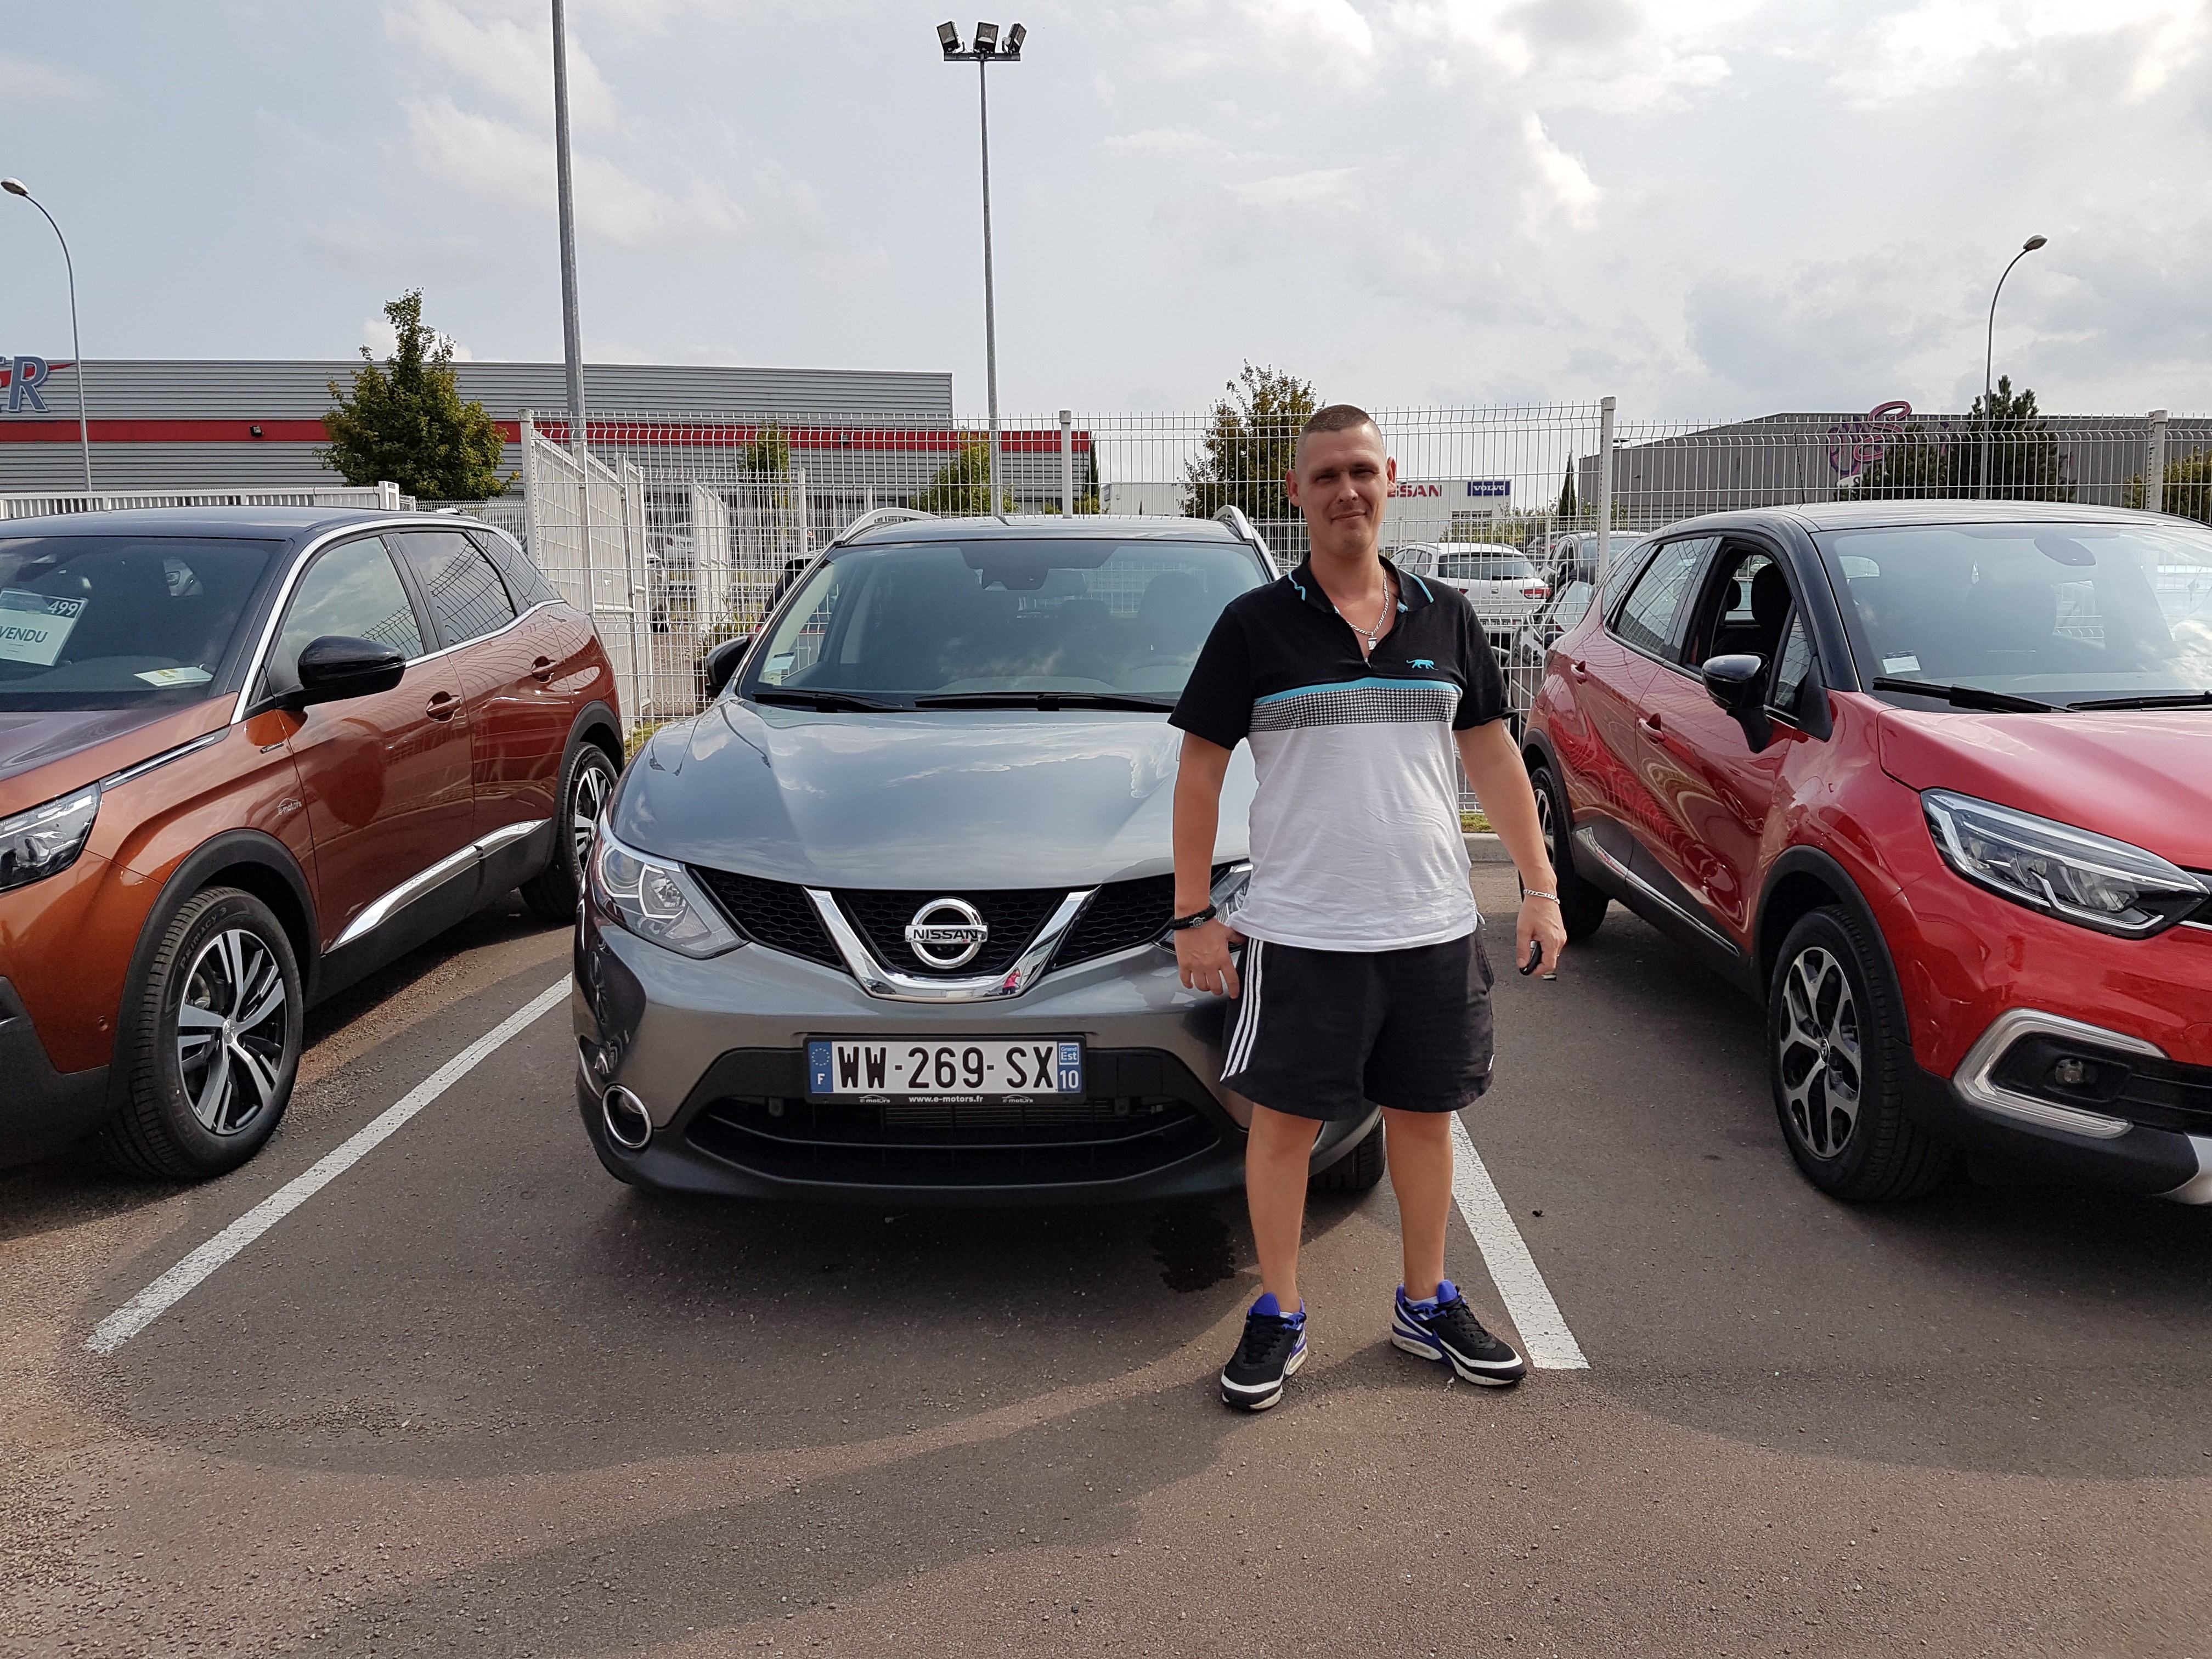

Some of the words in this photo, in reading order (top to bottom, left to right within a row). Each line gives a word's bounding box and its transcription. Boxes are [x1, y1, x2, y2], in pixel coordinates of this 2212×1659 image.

[0, 355, 49, 413] R
[47, 600, 78, 616] 499
[0, 625, 48, 643] VENDU
[913, 929, 978, 939] NISSAN
[1060, 1052, 1077, 1060] Est
[817, 1073, 825, 1085] F
[1060, 1070, 1079, 1088] 10
